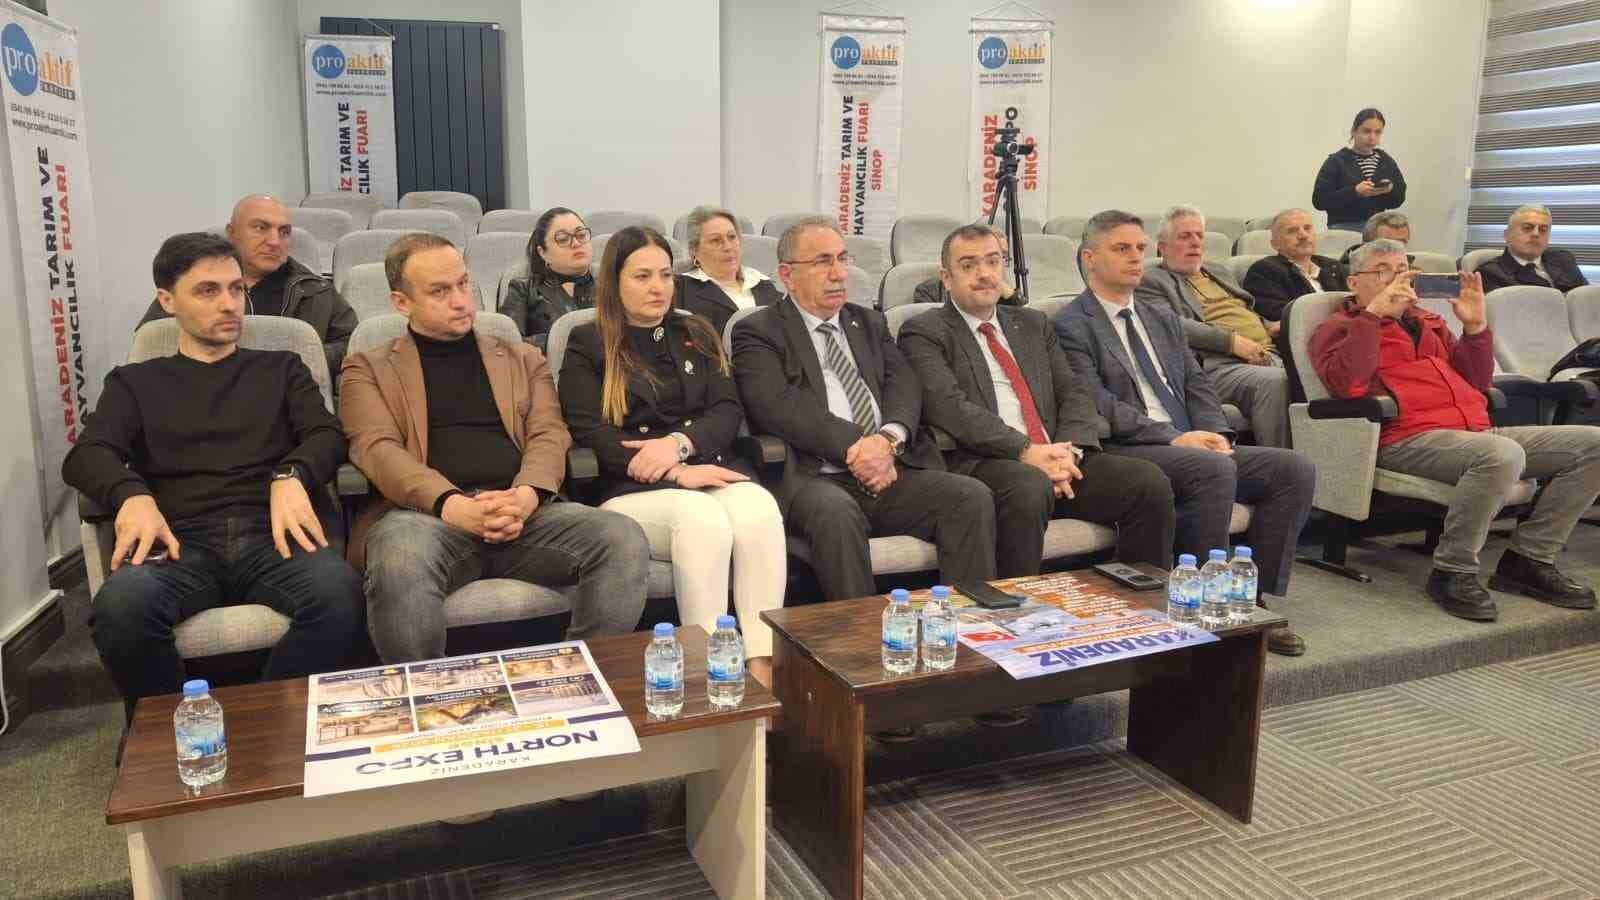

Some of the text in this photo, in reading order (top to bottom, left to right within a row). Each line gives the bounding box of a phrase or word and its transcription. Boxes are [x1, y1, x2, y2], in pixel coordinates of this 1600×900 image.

[338, 102, 350, 123] VE
[356, 110, 369, 155] FUARI
[340, 126, 352, 174] TARIM
[838, 95, 854, 235] ARADENİZ TARIM VE
[853, 102, 869, 235] HAYVANCILIK FUARI
[869, 149, 882, 191] SİNOP
[37, 146, 78, 444] ARADENİZ TARIM VE
[55, 164, 87, 427] AYVANCILIK FUARI
[355, 750, 463, 775] EXPO
[475, 730, 598, 759] NORTH
